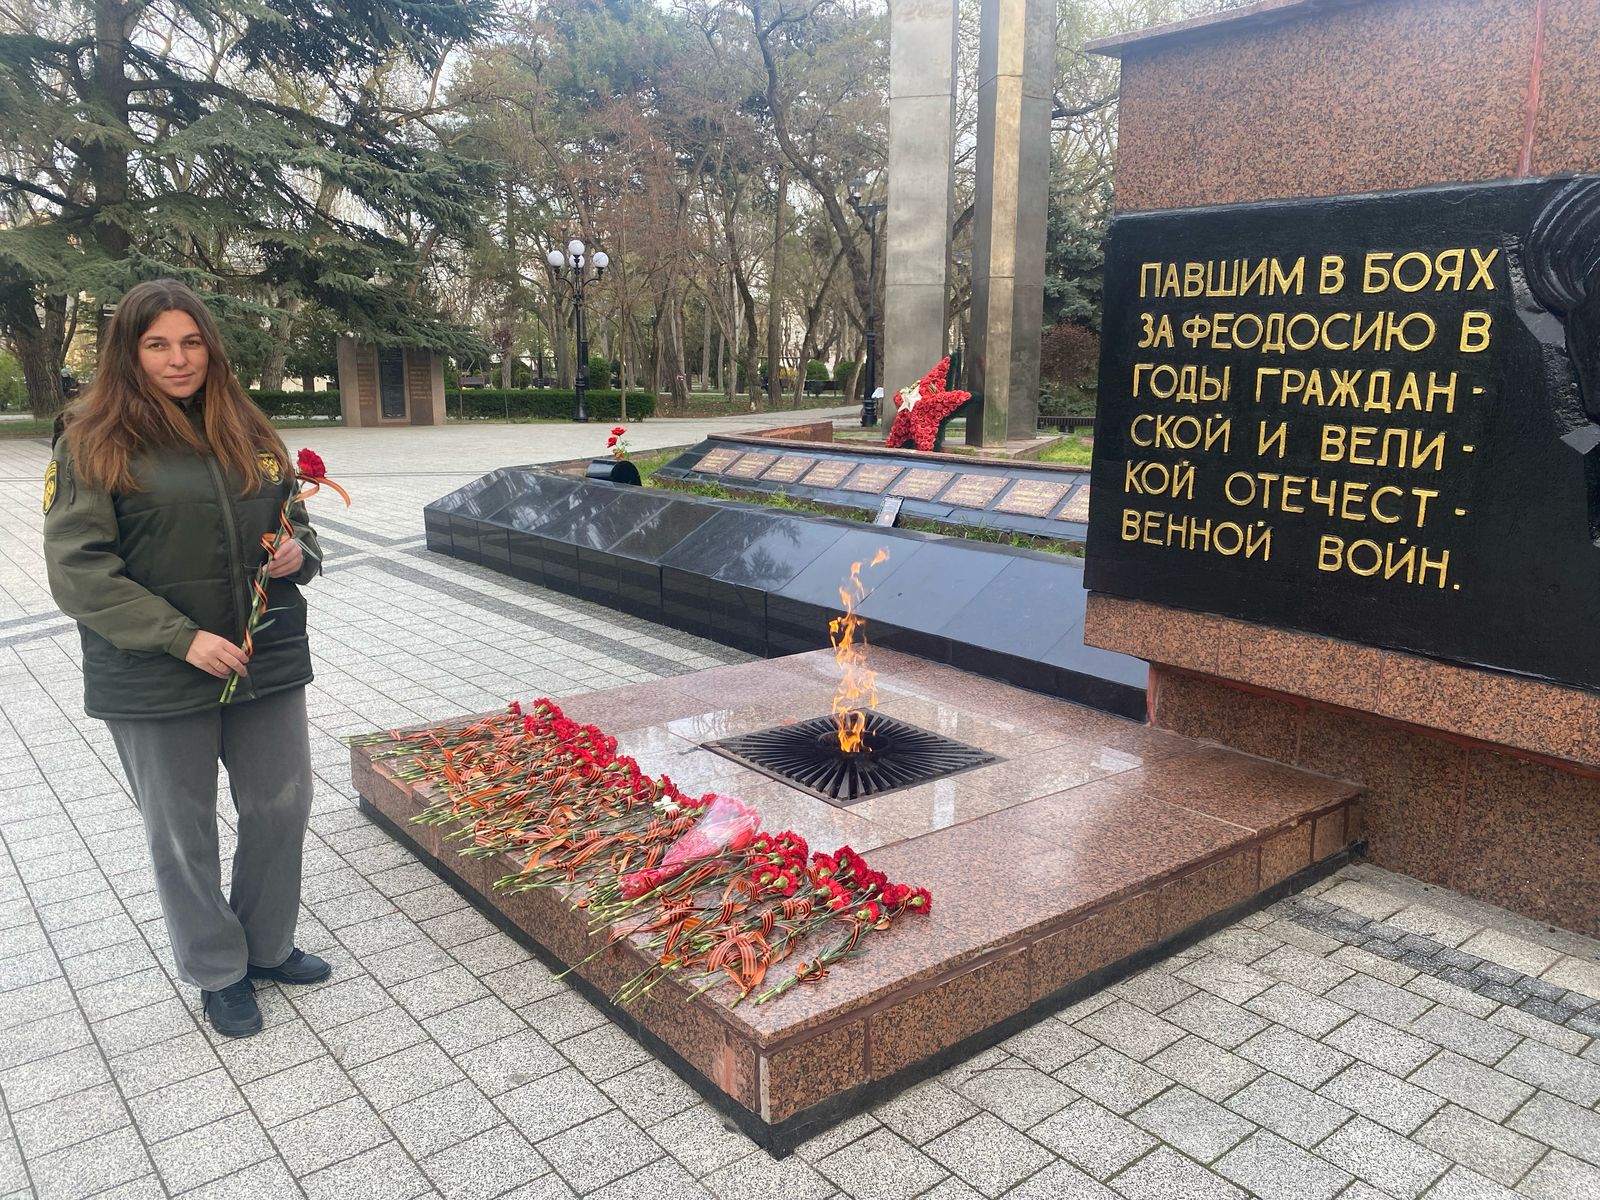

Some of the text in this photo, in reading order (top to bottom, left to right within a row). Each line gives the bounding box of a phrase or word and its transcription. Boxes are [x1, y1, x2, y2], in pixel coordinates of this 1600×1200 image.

[1139, 247, 1499, 298] ПАВШИМ В БОЯХ
[1137, 310, 1493, 354] ЗА ФЕОДОСИЮ В
[1132, 363, 1231, 404] ГОДЫ
[1130, 412, 1231, 453] СКОЙ
[1257, 421, 1287, 459] И
[1124, 458, 1195, 499] КОЙ
[1121, 508, 1461, 591] ВЕННОЙ ВОЙН.
